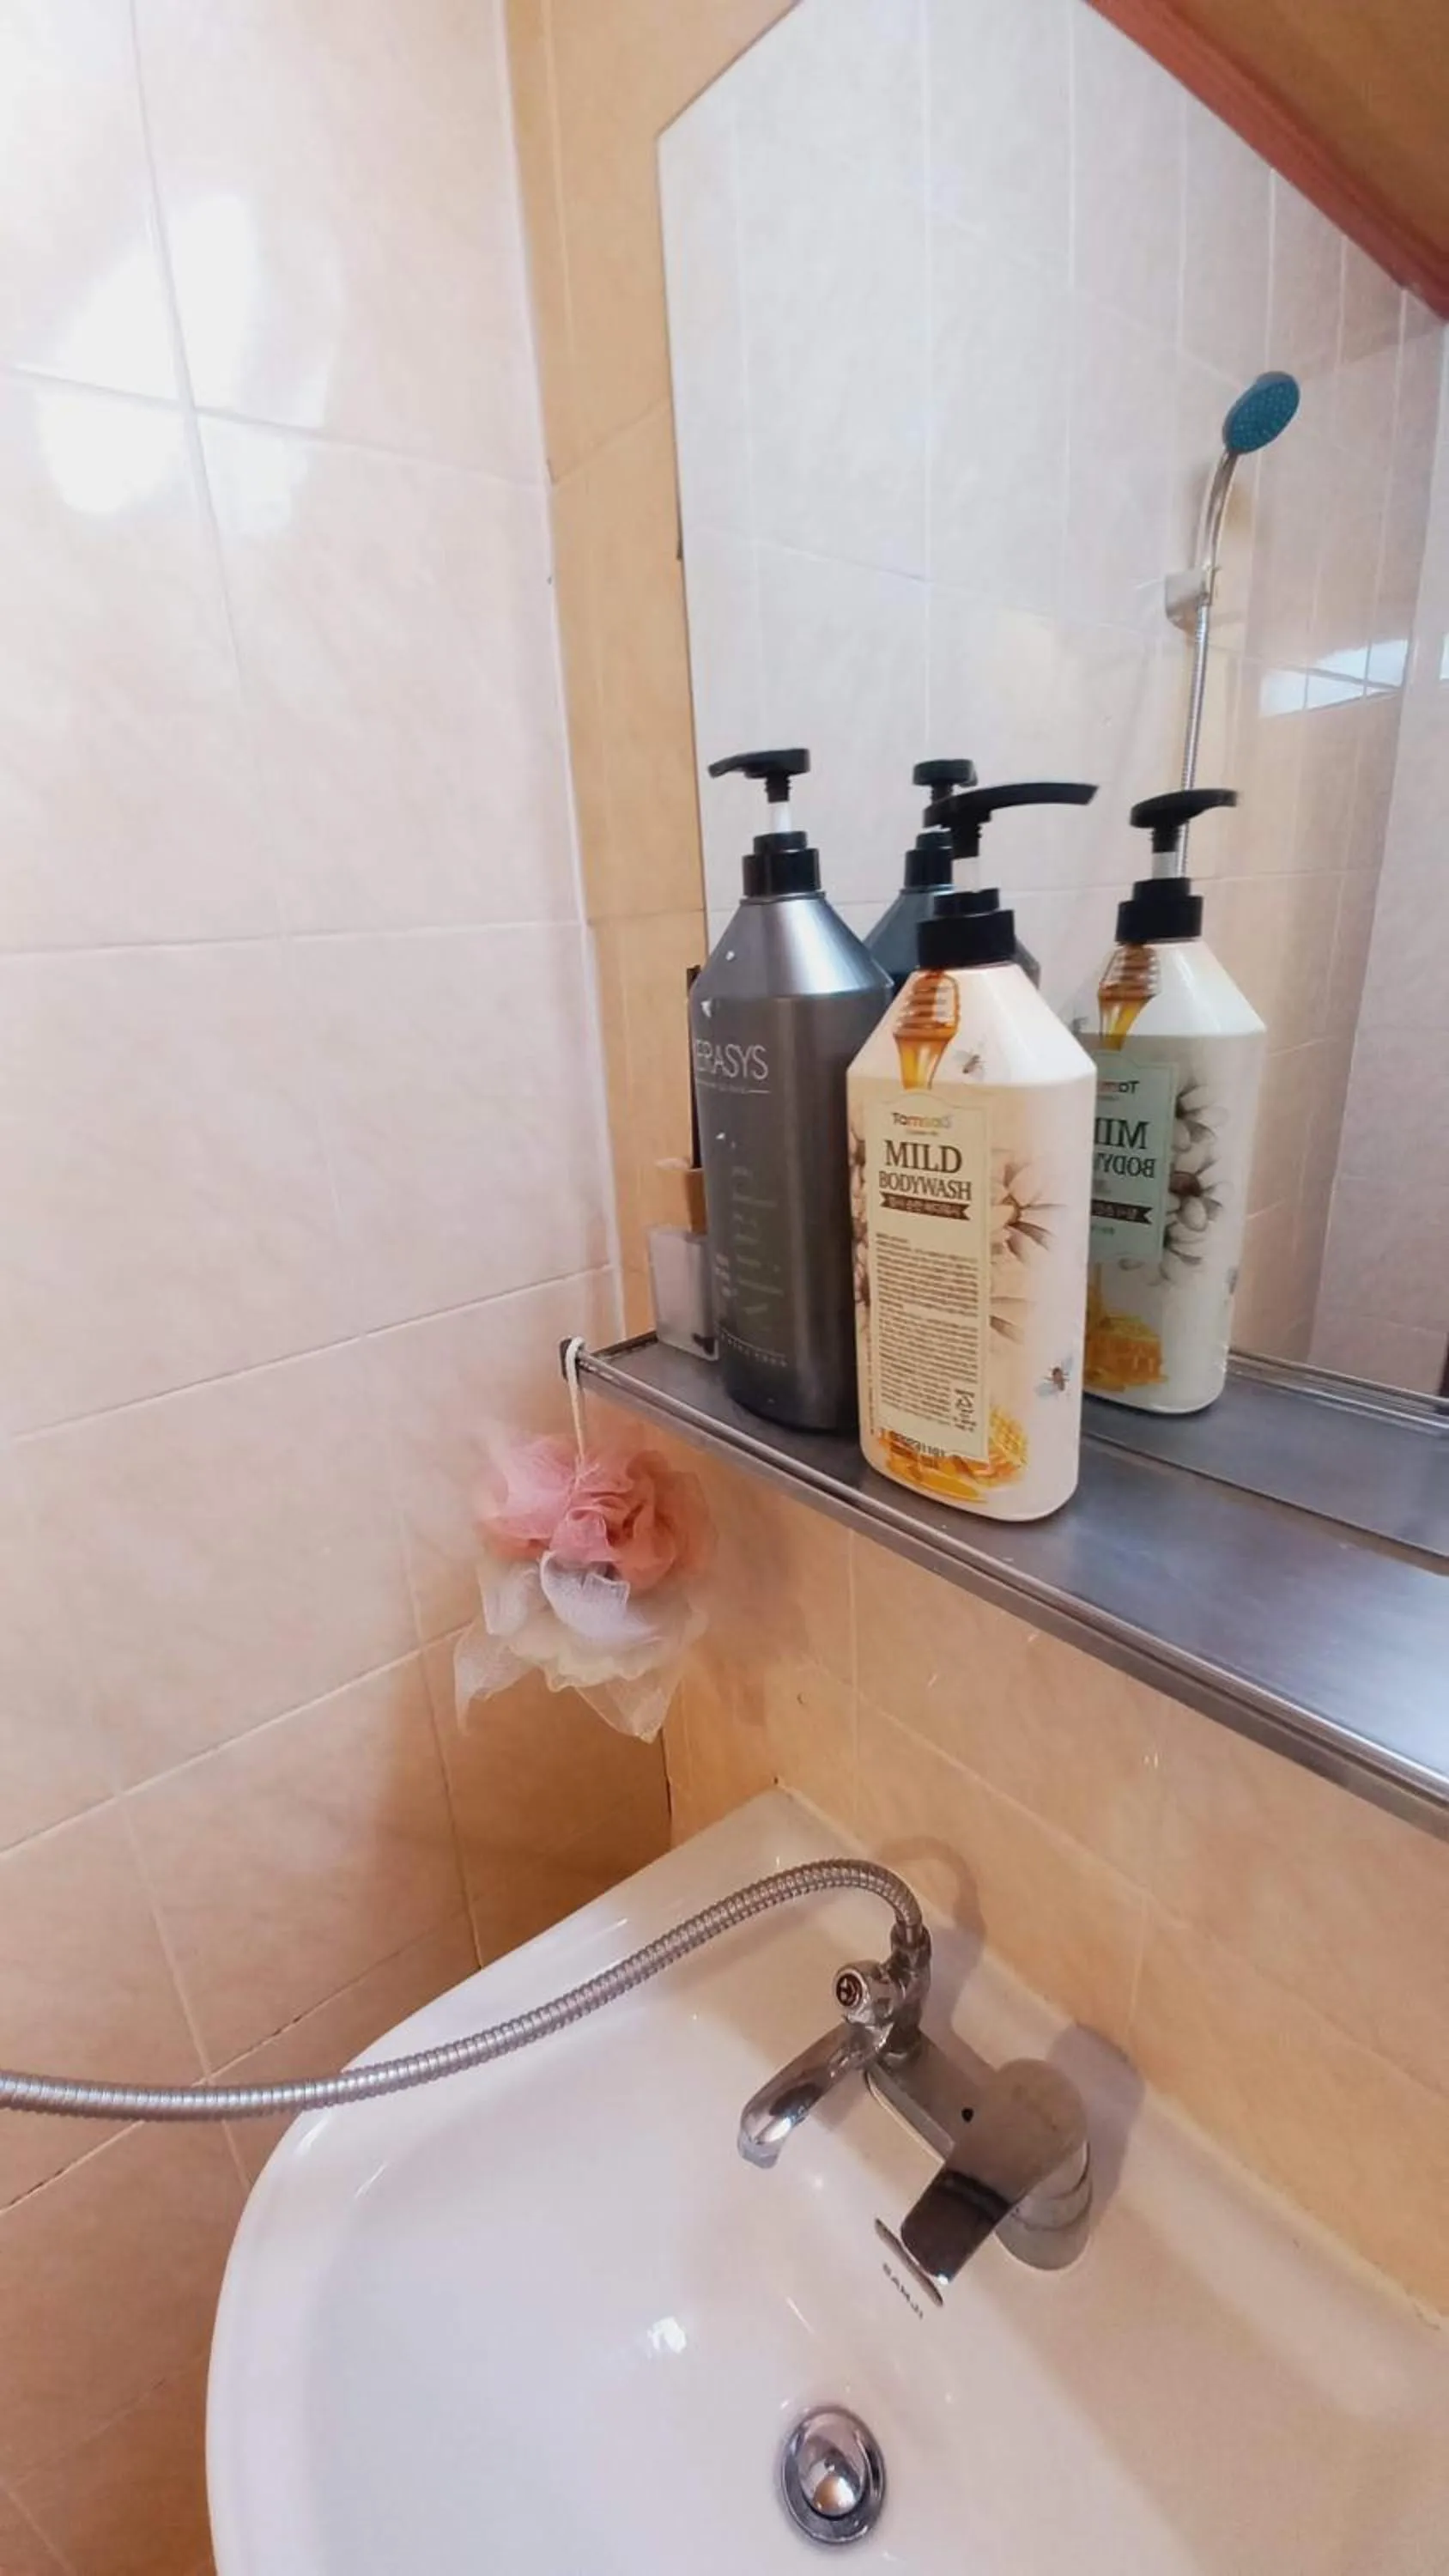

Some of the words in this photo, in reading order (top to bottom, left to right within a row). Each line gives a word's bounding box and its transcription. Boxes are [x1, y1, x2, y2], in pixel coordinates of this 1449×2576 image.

[695, 1038, 768, 1080] ERASYS
[884, 1139, 962, 1174] MILD
[878, 1170, 972, 1201] BODYWASH
